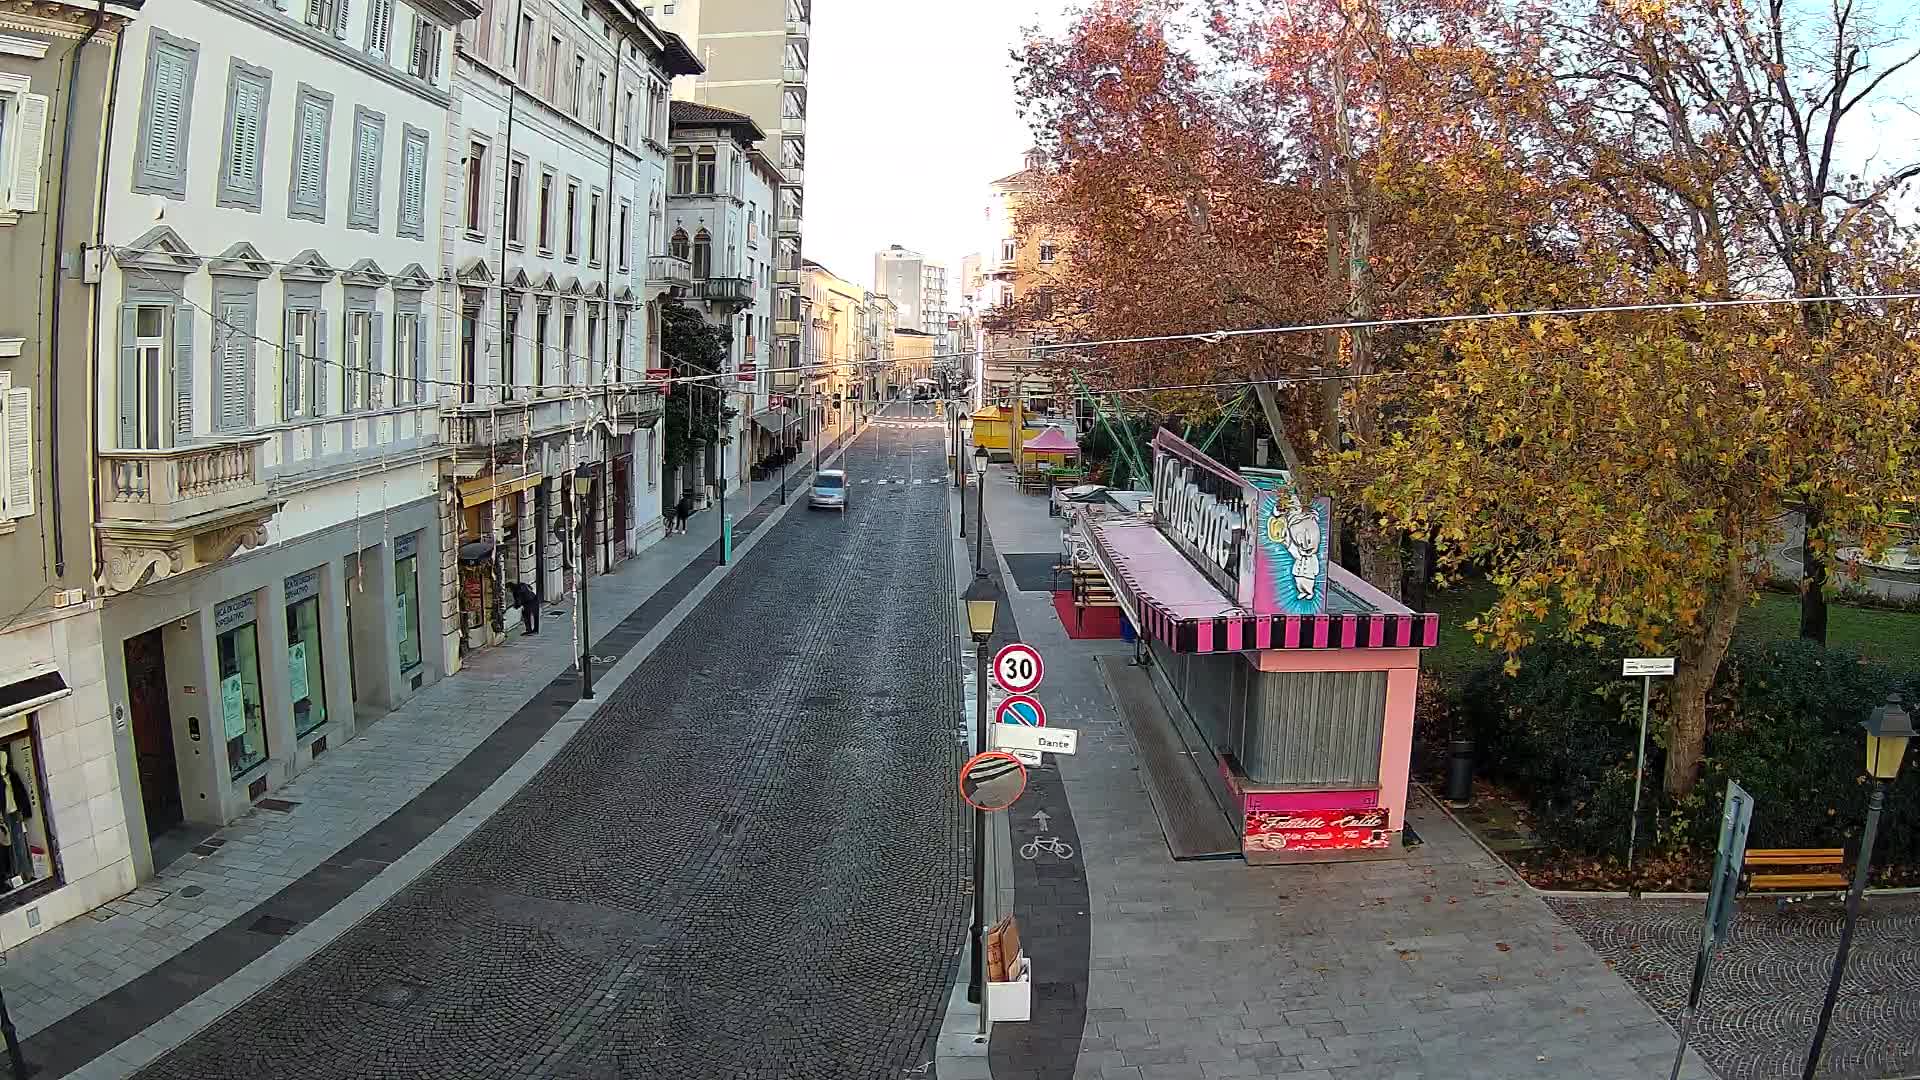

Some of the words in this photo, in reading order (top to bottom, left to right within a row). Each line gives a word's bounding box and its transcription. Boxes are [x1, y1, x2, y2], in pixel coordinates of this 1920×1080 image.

[1163, 458, 1233, 570] Golosone
[1005, 658, 1032, 680] 30
[1038, 737, 1070, 749] Dante
